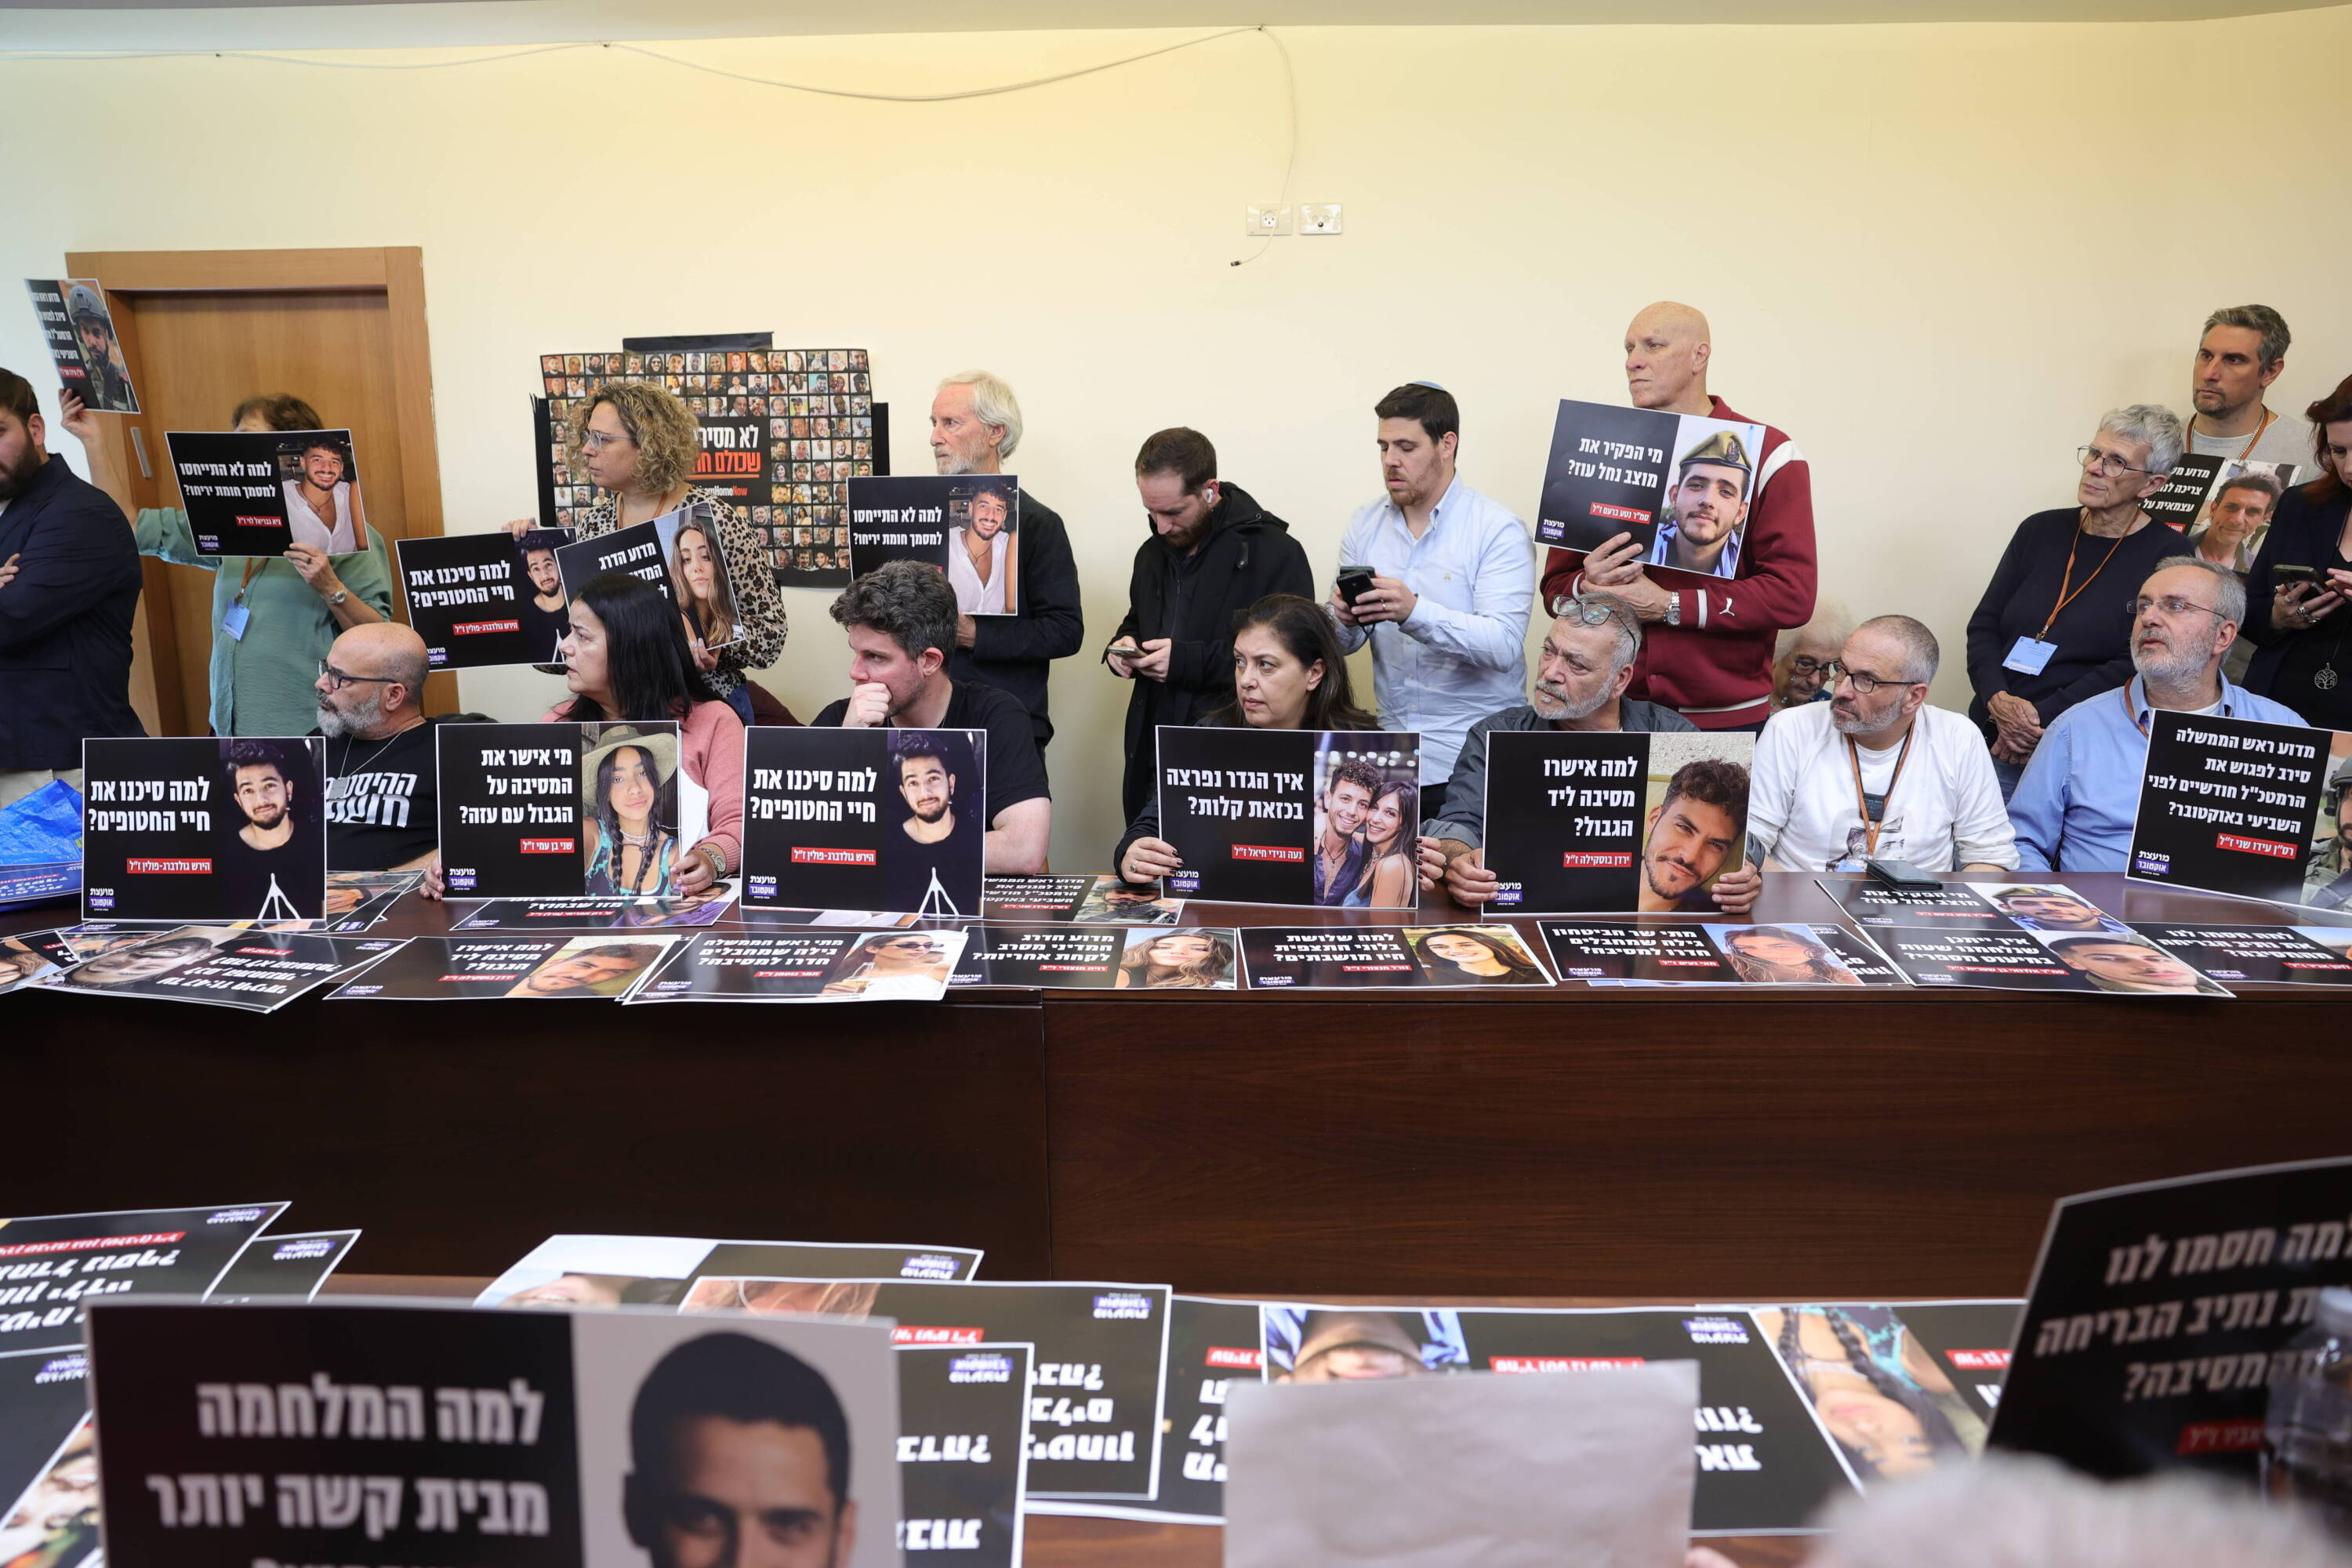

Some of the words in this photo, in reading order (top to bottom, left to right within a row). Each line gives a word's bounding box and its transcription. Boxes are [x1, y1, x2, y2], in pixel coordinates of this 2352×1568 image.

[739, 424, 759, 448] לא
[1579, 437, 1600, 454] את
[1604, 441, 1645, 460] הפקיר
[715, 449, 760, 472] שכולם
[1647, 448, 1663, 463] מי
[179, 463, 227, 476] התייחסו
[230, 461, 244, 476] לא
[248, 461, 271, 476] למה
[1568, 459, 1595, 478] עוז?
[1598, 461, 1621, 481] נחל
[2186, 467, 2210, 478] מדוע
[1624, 469, 1658, 488] מוצב
[183, 485, 213, 496] יריחו?
[215, 486, 241, 497] חומת
[242, 485, 275, 499] למסמך
[2174, 485, 2203, 495] צריכה
[1592, 504, 1602, 513] ז"ל
[2143, 499, 2154, 510] על
[2155, 501, 2194, 513] עצמאית
[853, 509, 898, 522] התייחסו
[902, 506, 915, 522] לא
[919, 506, 942, 522] למה
[1619, 510, 1632, 518] נטע
[1633, 511, 1650, 521] סמ"ר
[1543, 518, 1565, 528] מועצת
[853, 533, 880, 546] יריחו?
[882, 534, 908, 545] חומת
[909, 532, 942, 547] למסמך
[1543, 527, 1562, 536] אוקטובר
[627, 542, 656, 562] מדוע
[598, 550, 627, 571] הדרג
[409, 569, 435, 586] את
[437, 566, 475, 584] סיכנו
[478, 560, 510, 580] למה
[411, 587, 489, 608] החטופים?
[491, 585, 514, 601] חיי
[467, 623, 503, 633] גולדברג-פולין
[2176, 728, 2239, 749] הממשלה
[2243, 739, 2274, 754] ראש
[481, 750, 506, 766] את
[509, 749, 550, 765] אישר
[554, 749, 572, 765] מי
[2278, 742, 2316, 759] מדוע
[1544, 759, 1597, 776] אישרו
[1601, 757, 1638, 777] למה
[2205, 758, 2227, 773] את
[2230, 760, 2275, 779] לפגוש
[753, 769, 782, 789] את
[786, 770, 833, 791] סיכנו
[837, 768, 877, 793] למה
[1167, 768, 1222, 788] נפרצה
[1225, 771, 1269, 790] הגדר
[1273, 773, 1304, 793] איך
[2147, 775, 2177, 790] לפני
[2278, 768, 2311, 784] סירב
[91, 781, 116, 801] את
[120, 781, 165, 801] סיכנו
[169, 776, 210, 801] למה
[487, 775, 507, 795] על
[511, 778, 572, 794] המסיבה
[2179, 779, 2238, 798] חודשיים
[1548, 786, 1576, 807] ליד
[1581, 789, 1635, 807] מסיבה
[2241, 786, 2306, 808] הרמטכ"ל
[459, 806, 498, 823] עזה?
[502, 807, 524, 823] עם
[528, 803, 572, 823] הגבול
[750, 796, 842, 822] החטופים?
[848, 801, 876, 822] חיי
[1188, 796, 1243, 820] קלות?
[1248, 800, 1304, 820] בכזאת
[2169, 801, 2243, 826] באוקטובר?
[88, 808, 176, 831] החטופים?
[180, 811, 211, 831] חיי
[1574, 816, 1633, 837] הגבול?
[2248, 813, 2301, 833] השביעי
[522, 840, 535, 850] ז"ל
[536, 841, 550, 850] עמי
[551, 841, 558, 851] בן
[560, 841, 572, 850] שני
[2220, 834, 2234, 847] ז"ל
[2235, 839, 2251, 849] שני
[2252, 841, 2272, 852] עידו
[794, 850, 805, 859] ז"ל
[807, 851, 855, 862] גולדברג-פולין
[856, 853, 873, 862] הירש
[1234, 847, 1247, 856] ז"ל
[1248, 847, 1267, 858] חיאל
[1269, 850, 1286, 858] וגידי
[1287, 851, 1302, 859] נעה
[2139, 851, 2170, 862] מועצת
[2272, 844, 2294, 856] רס"ן
[129, 860, 141, 870] ז"ל
[142, 860, 190, 872] גולדברג-פולין
[191, 862, 210, 870] הירש
[1566, 854, 1579, 864] ז"ל
[1580, 854, 1612, 866] בוסקילה
[1614, 856, 1629, 866] ירדן
[2139, 861, 2166, 872] אוקטובר
[750, 886, 775, 895] אוקטובר
[1172, 880, 1198, 888] אוקטובר
[699, 947, 791, 956] שמחבלים
[1054, 953, 1110, 962] לקחת
[698, 956, 782, 965] למסיבה?
[2283, 1215, 2352, 1261] מה
[2106, 1232, 2168, 1285] לנו
[2172, 1228, 2274, 1276] חסמו
[2188, 1290, 2278, 1333] נתיב
[2035, 1301, 2183, 1357] הבריחה
[196, 1372, 425, 1440] המלחמה
[435, 1377, 544, 1445] למה
[146, 1472, 264, 1527] יותר
[275, 1474, 402, 1540] קשה
[415, 1477, 550, 1537] מבית
